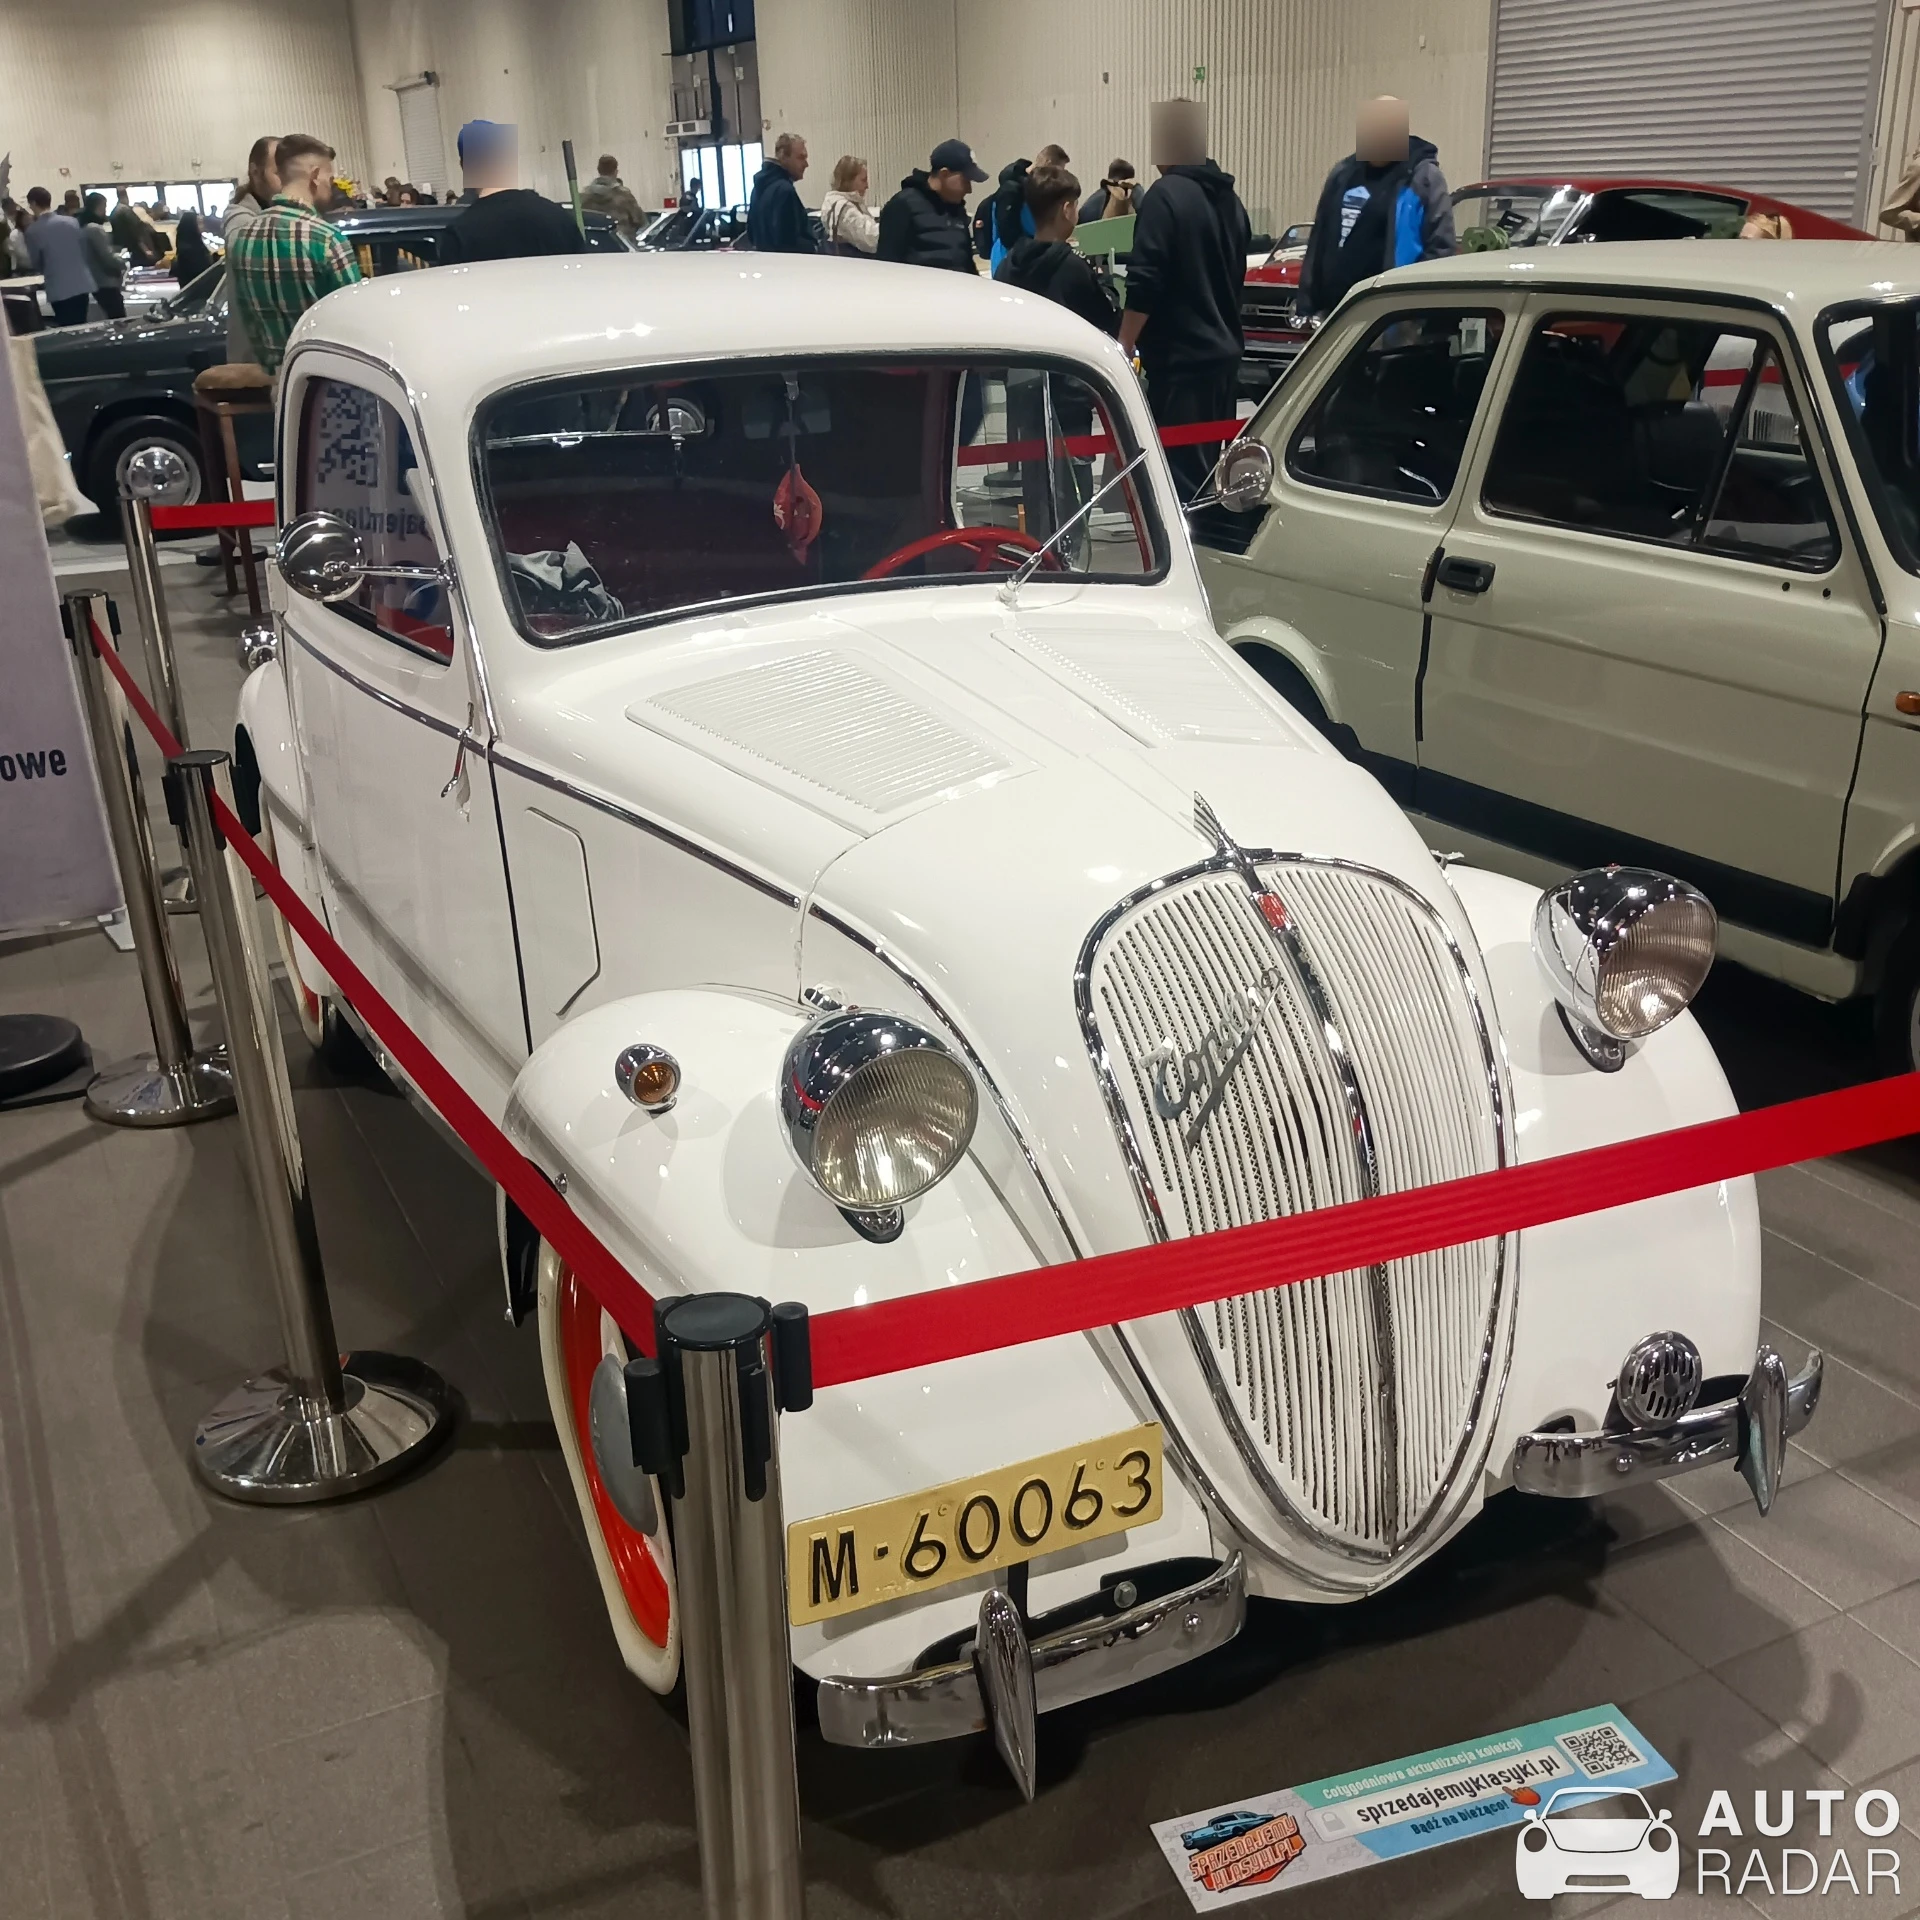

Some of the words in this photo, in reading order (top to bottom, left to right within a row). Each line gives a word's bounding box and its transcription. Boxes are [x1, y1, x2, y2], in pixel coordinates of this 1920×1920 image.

[1322, 1769, 1405, 1800] Cotygodniowa
[1406, 1752, 1478, 1778] aktualizacja
[1477, 1737, 1523, 1760] kolekcji
[1356, 1754, 1561, 1825] sprzedajemyklasyki.pl
[1189, 1815, 1298, 1880] SPRZEDAJEMY
[1410, 1816, 1444, 1835] Bądź
[1445, 1814, 1459, 1827] na
[1460, 1799, 1510, 1824] bieżąco!
